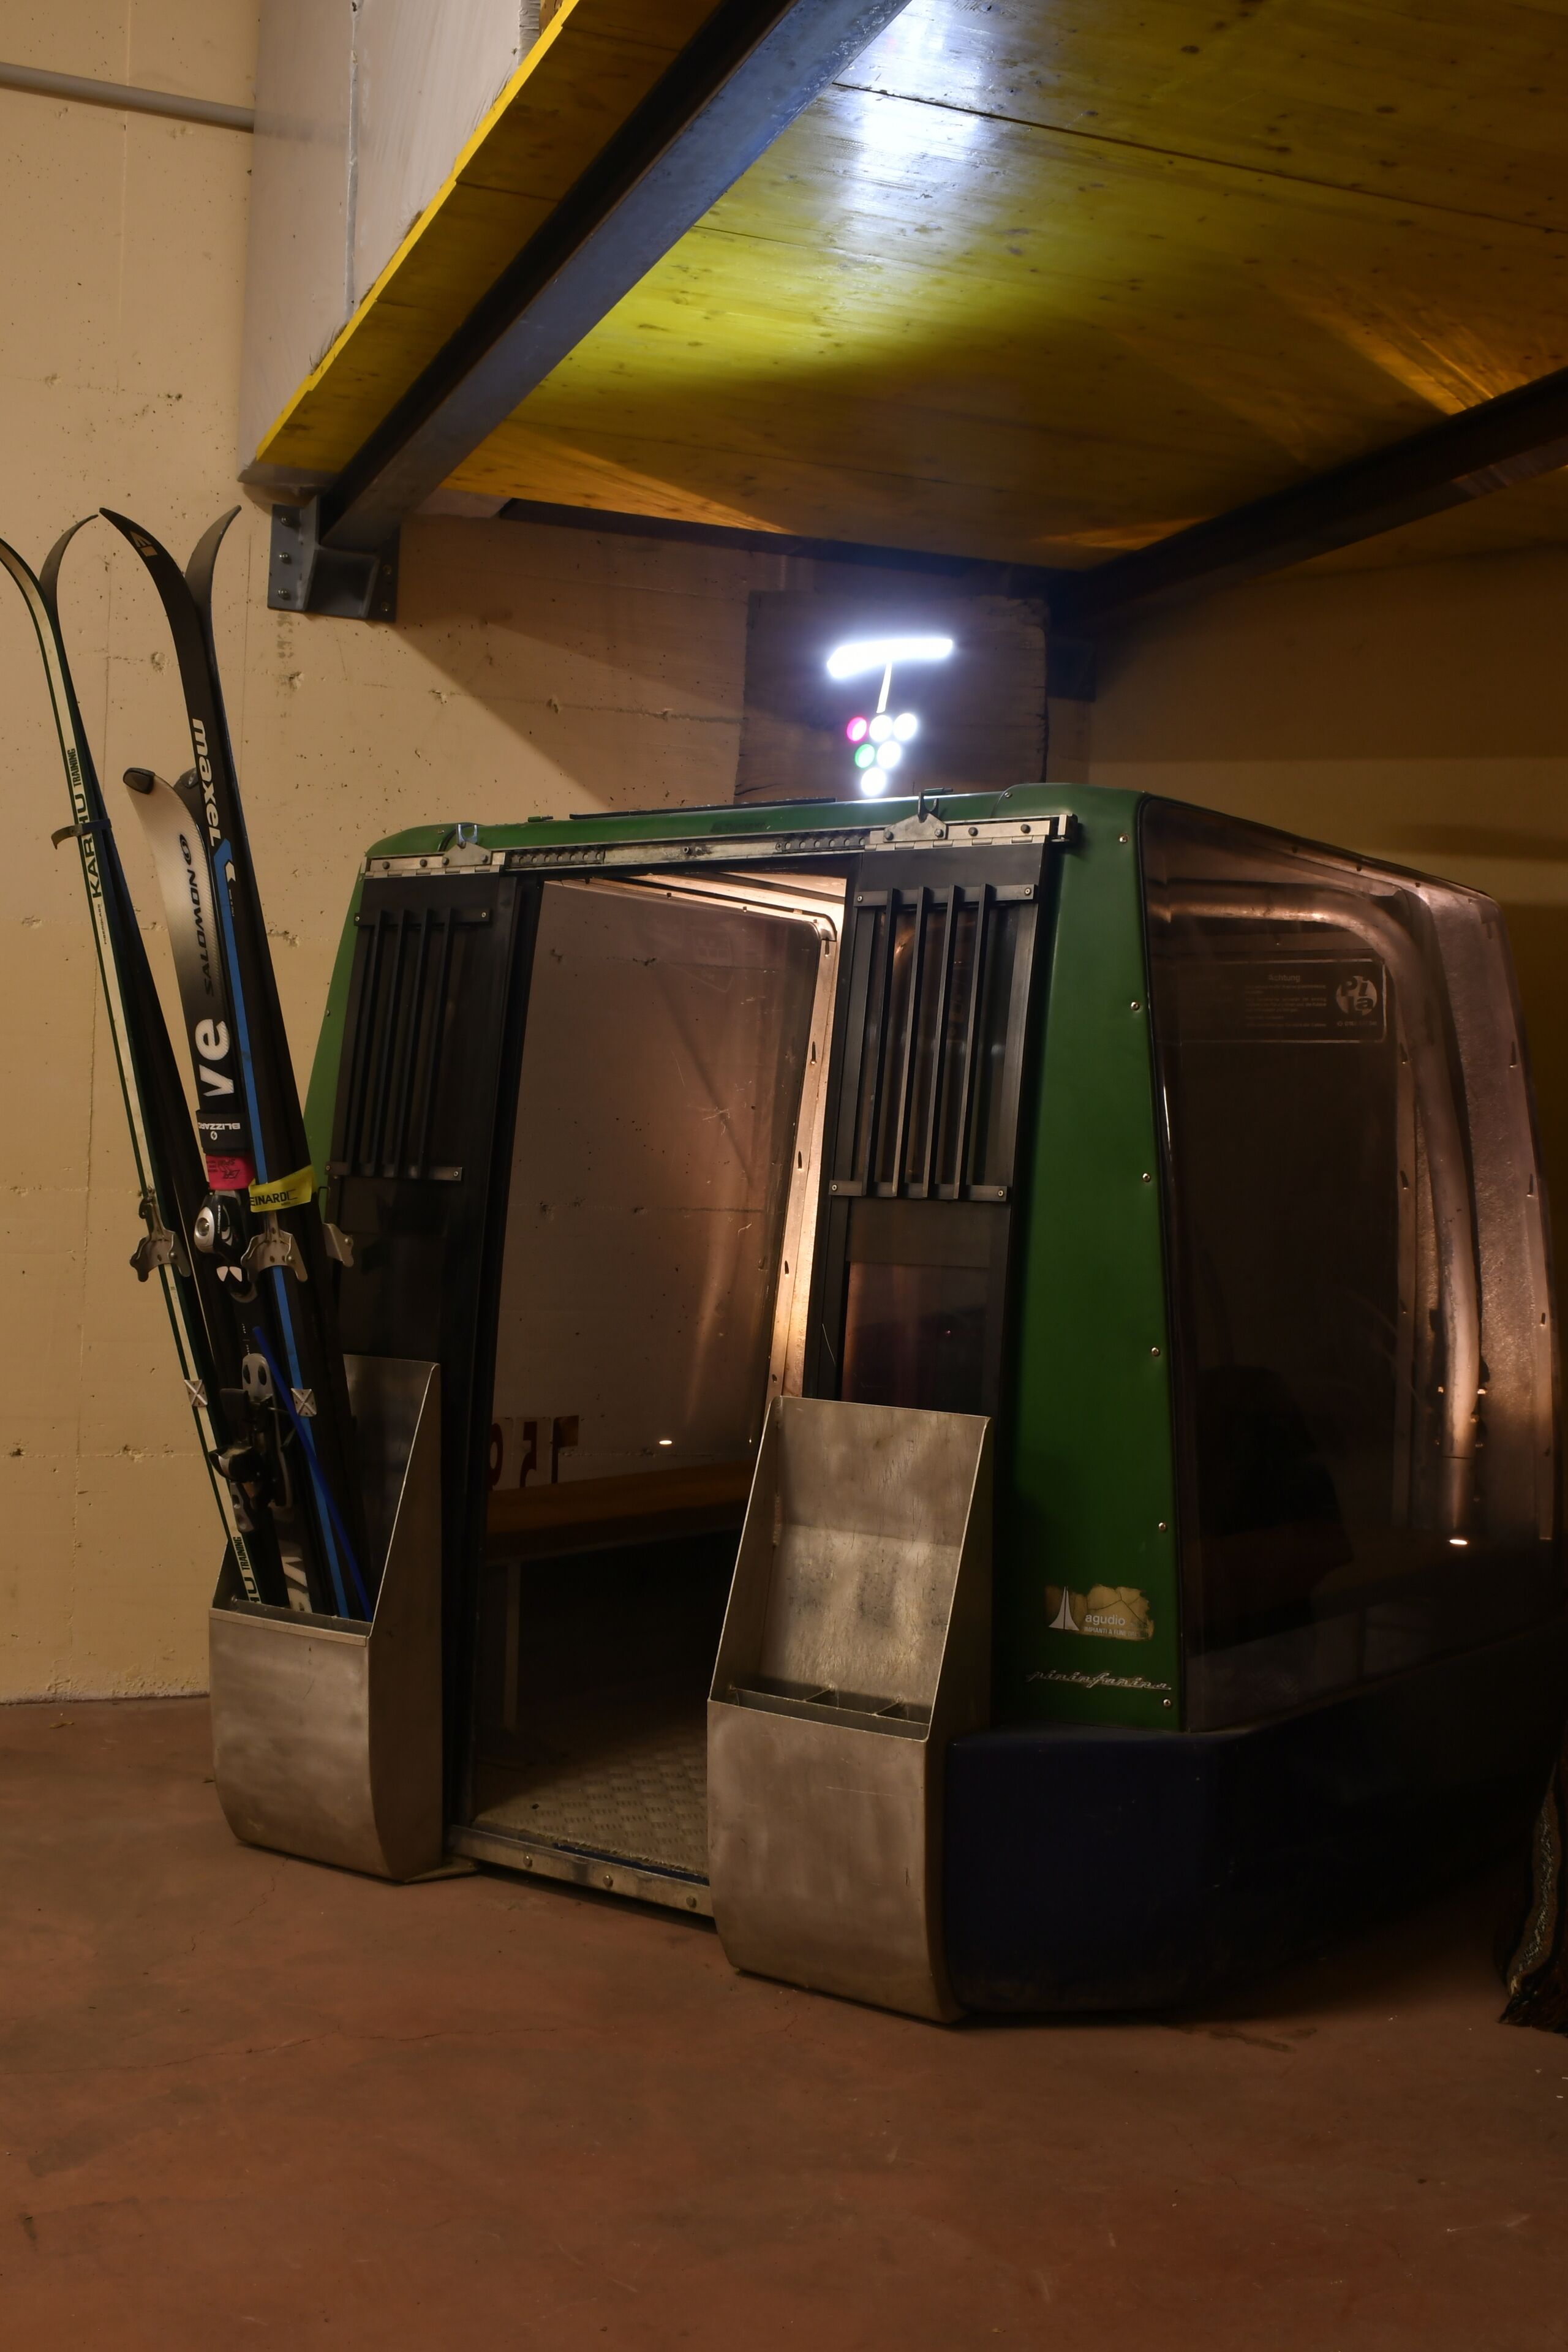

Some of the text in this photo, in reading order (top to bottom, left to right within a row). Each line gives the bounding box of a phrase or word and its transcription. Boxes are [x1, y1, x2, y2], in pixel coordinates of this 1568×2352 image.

[67, 748, 81, 788] TRAINING
[187, 869, 214, 997] SALOMON
[1268, 974, 1301, 983] Achtung
[233, 1536, 250, 1570] TRAINING
[1085, 1613, 1126, 1626] agudio
[1025, 1670, 1172, 1691] pininfarina
